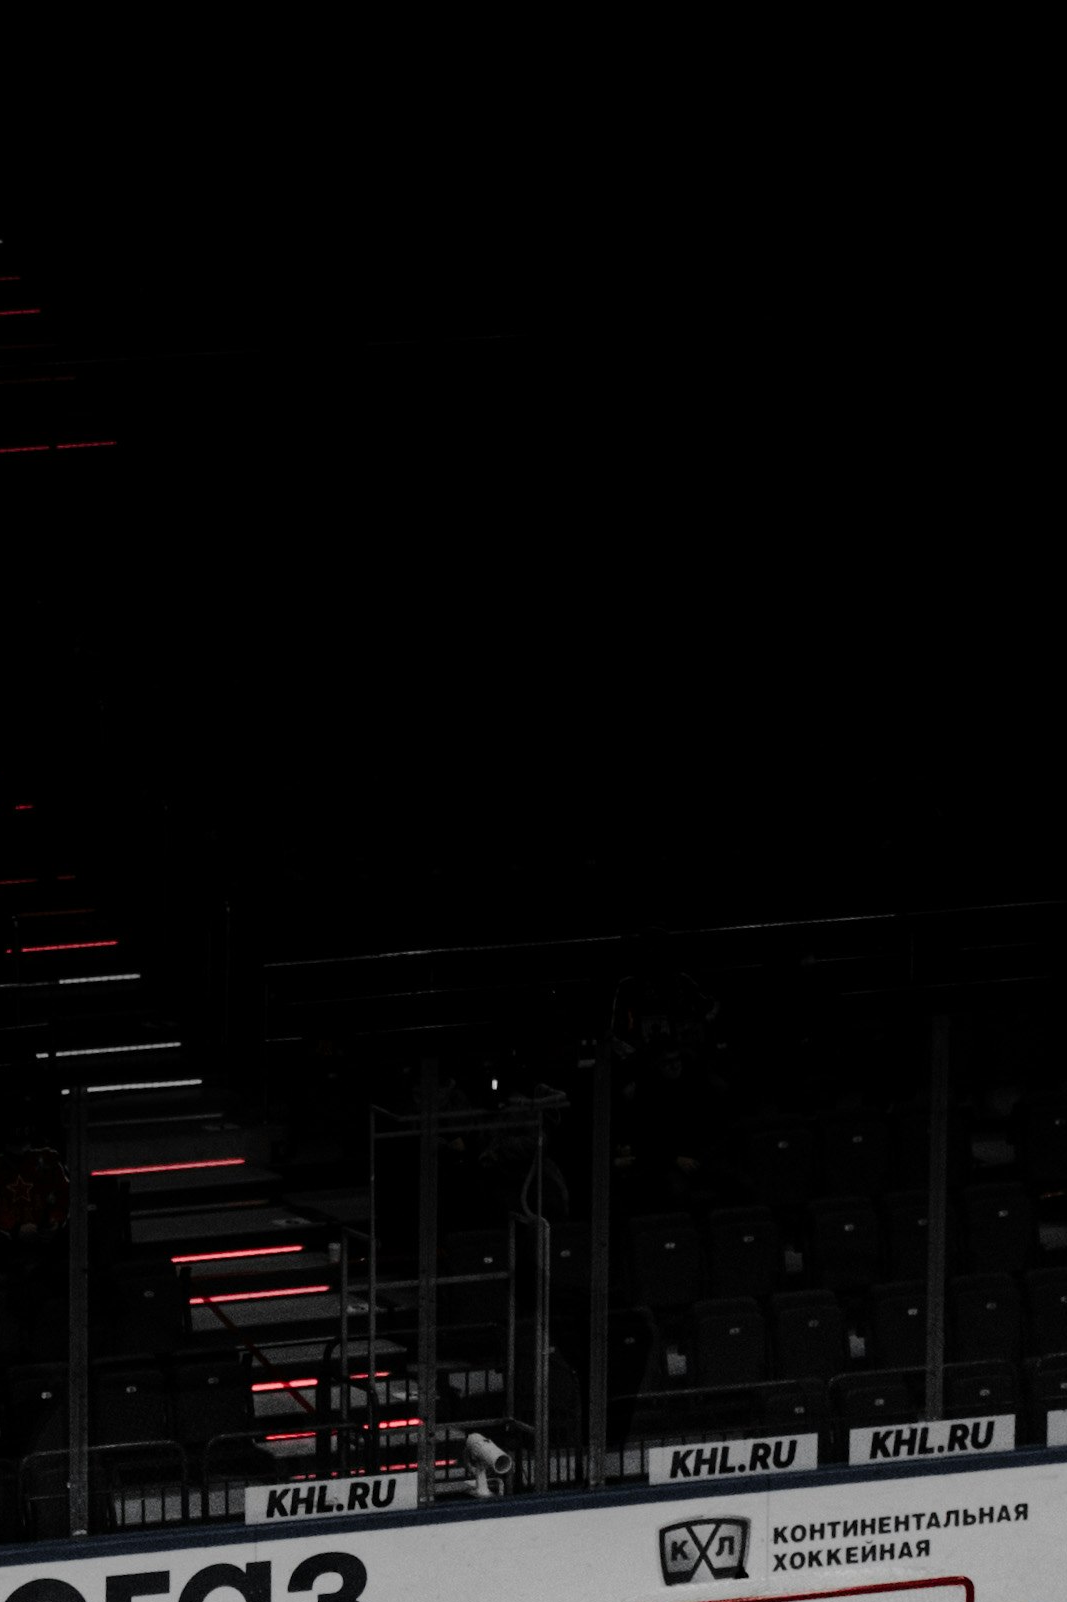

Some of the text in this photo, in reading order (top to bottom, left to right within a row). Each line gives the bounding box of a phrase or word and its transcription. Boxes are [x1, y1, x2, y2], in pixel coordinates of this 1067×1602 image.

[669, 1439, 798, 1479] KHL.RU
[868, 1420, 996, 1460] KHL.RU
[265, 1478, 397, 1518] KHL.RU
[772, 1503, 1030, 1545] КОНТИНЕНТАЛЬНАЯ
[772, 1539, 931, 1573] ХОККЕЙНАЯ
